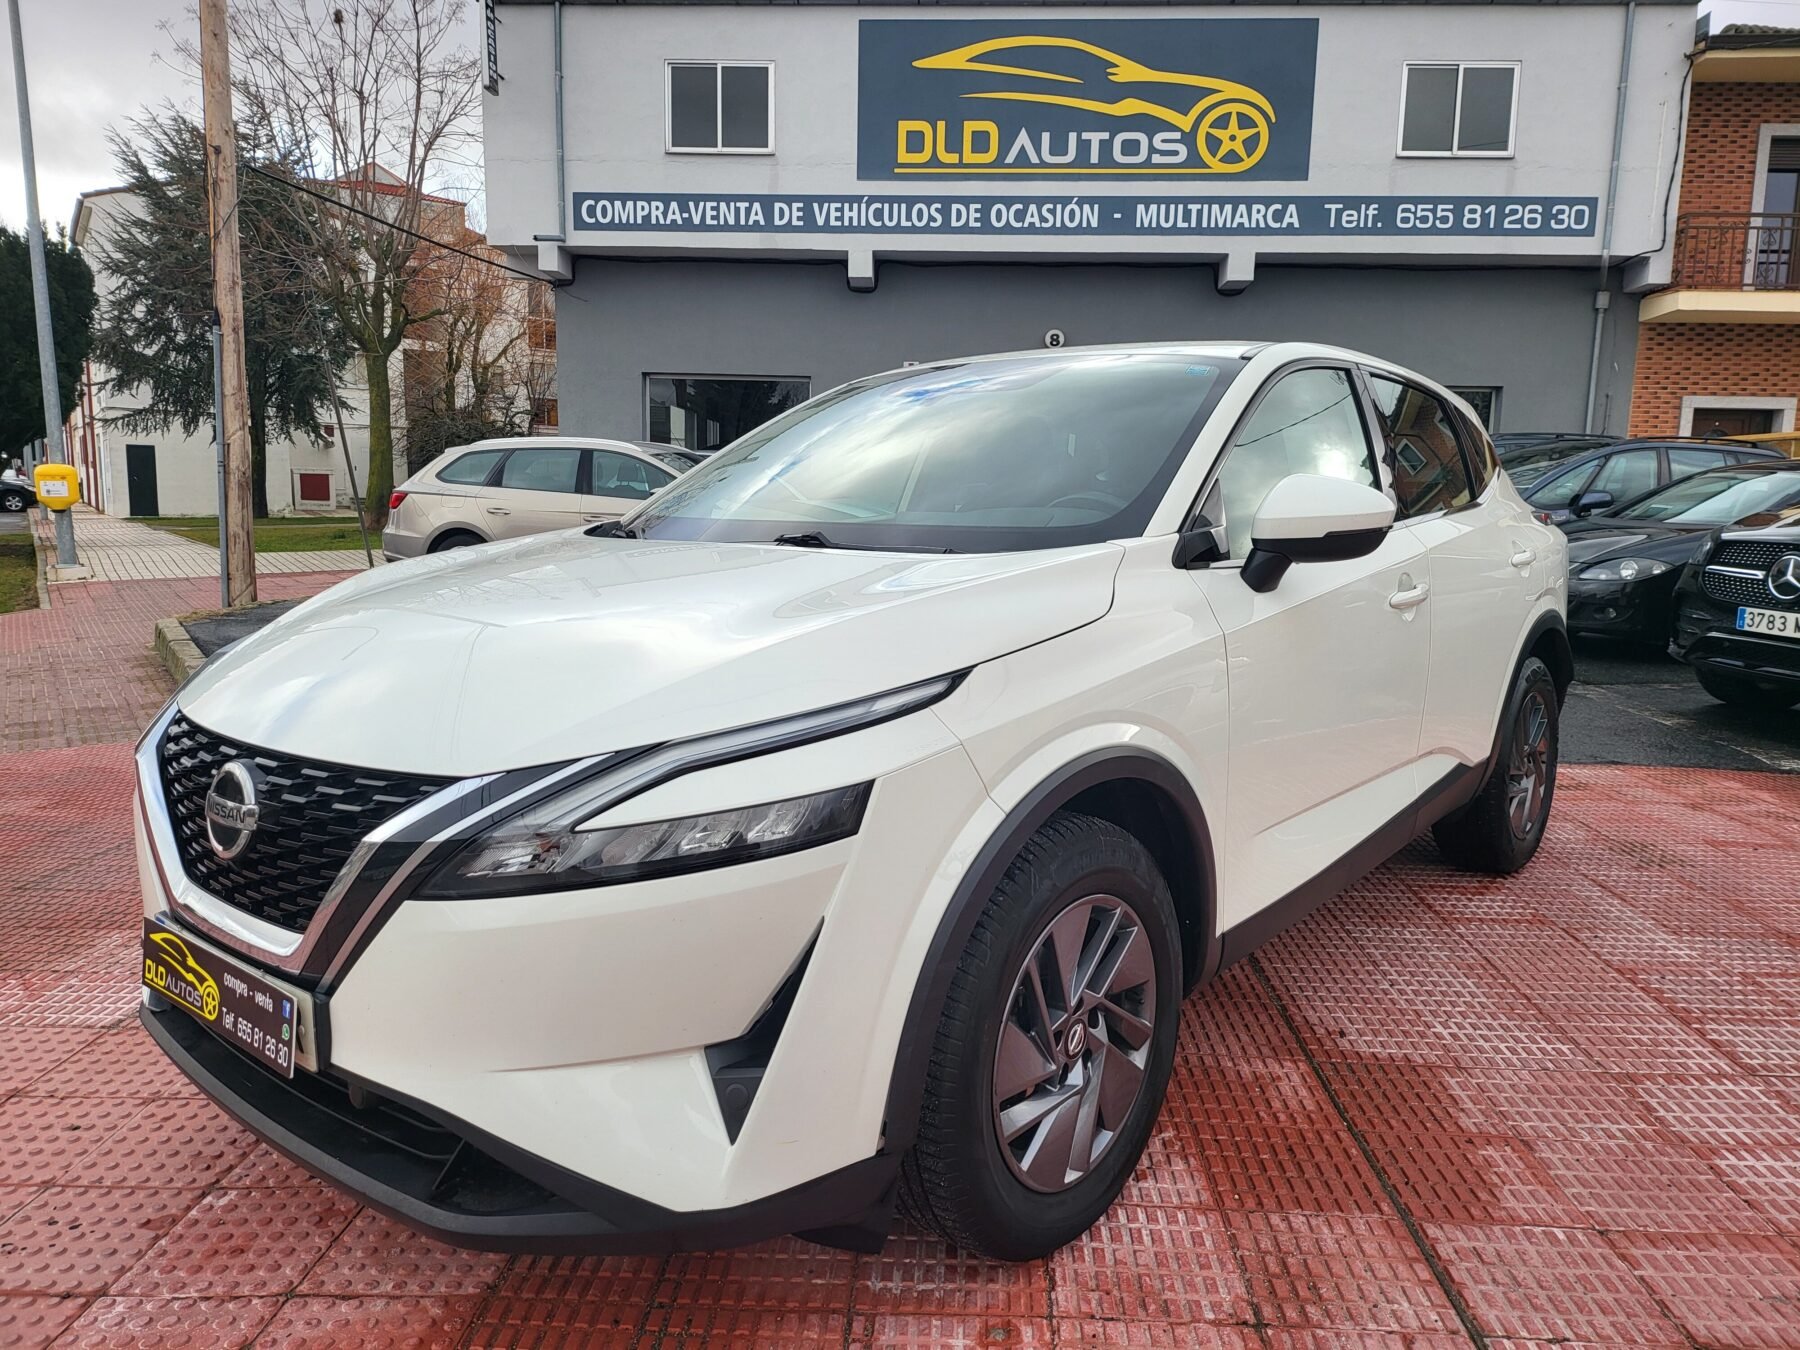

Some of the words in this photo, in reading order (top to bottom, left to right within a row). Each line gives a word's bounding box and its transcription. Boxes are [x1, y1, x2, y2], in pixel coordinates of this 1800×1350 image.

[897, 120, 999, 164] DLD
[1004, 126, 1188, 164] AUTOS
[581, 199, 765, 226] COMPRA-VENTA
[773, 202, 804, 226] DE
[812, 196, 943, 228] VEHÍCULOS
[950, 203, 982, 228] DE
[990, 197, 1099, 228] OCASIÓN
[1135, 203, 1300, 228] MULTIMARCA
[1324, 203, 1382, 228] Telf.
[1396, 204, 1454, 229] 655
[1550, 205, 1590, 230] 30
[1050, 333, 1060, 347] 8
[1746, 611, 1788, 632] 3783
[207, 797, 246, 824] NISSAN
[145, 958, 166, 987] DLD
[165, 973, 202, 1007] AUTOS
[223, 972, 248, 998] compra
[254, 990, 273, 1013] venta
[222, 1006, 235, 1032] Telf.
[237, 1017, 252, 1043] 655
[253, 1027, 263, 1050] 81
[265, 1035, 276, 1059] 26
[277, 1043, 289, 1067] 30
